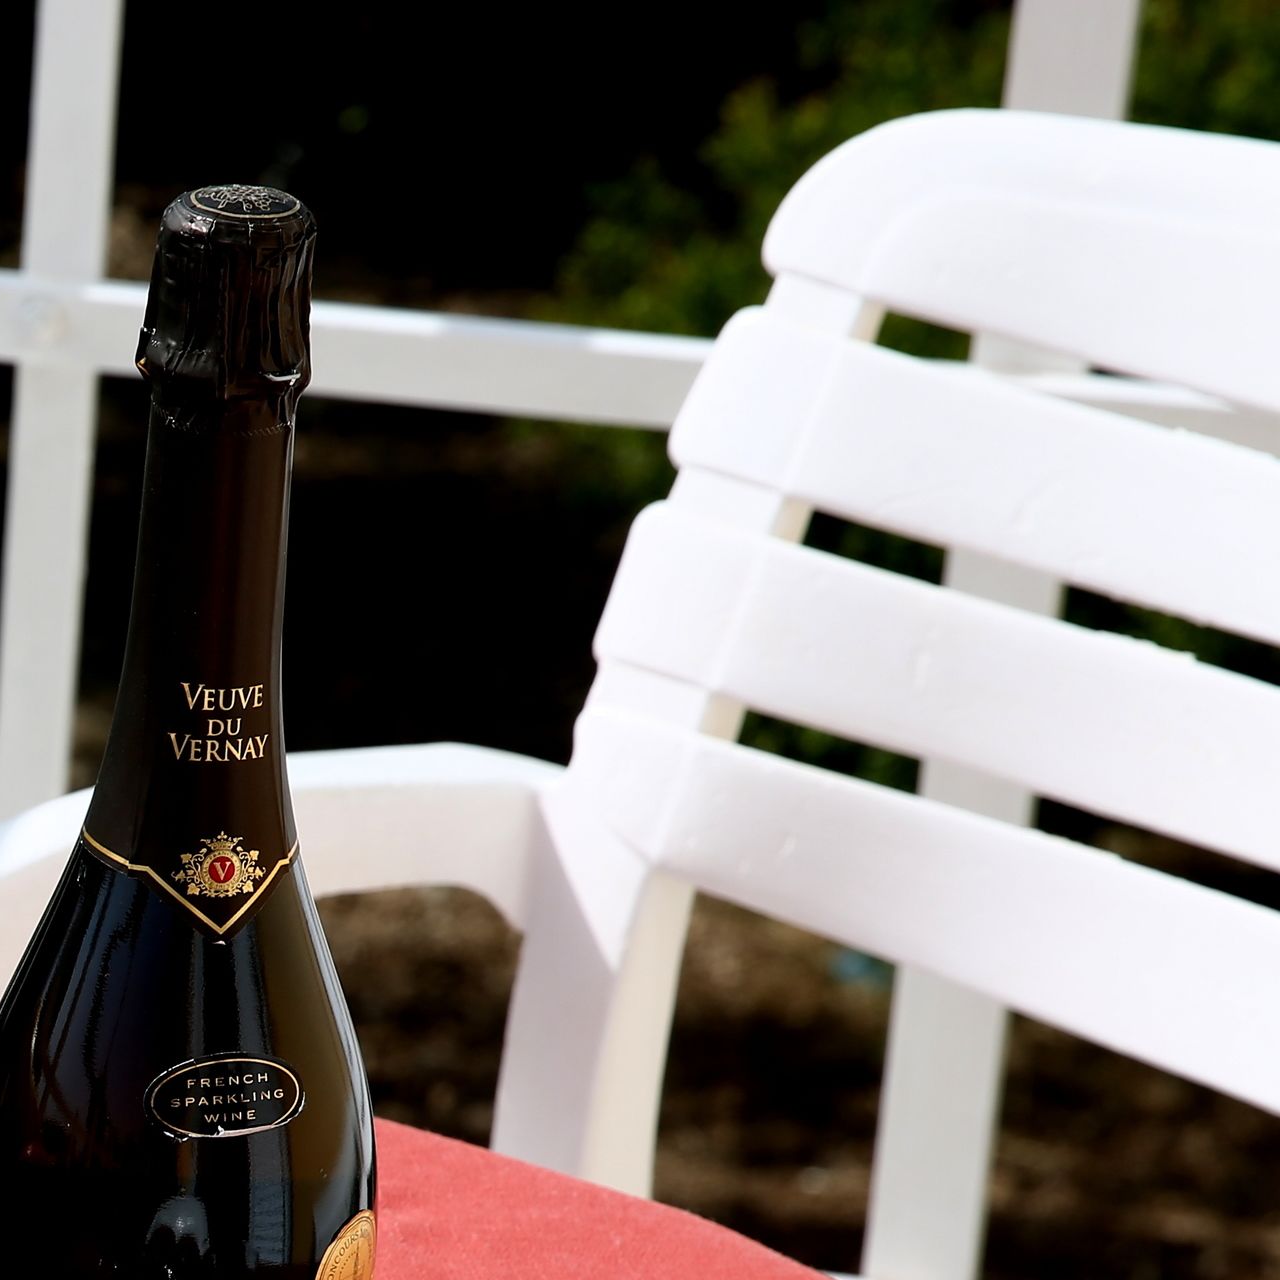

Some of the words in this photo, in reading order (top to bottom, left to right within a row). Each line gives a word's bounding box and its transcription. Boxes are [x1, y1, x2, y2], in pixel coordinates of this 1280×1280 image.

[180, 682, 264, 711] VEUVE
[207, 718, 242, 737] DU
[167, 732, 269, 762] VERNAY
[213, 861, 231, 881] V
[187, 1072, 268, 1089] FRENCH
[170, 1088, 284, 1108] SPARKLING
[204, 1109, 256, 1123] WINE
